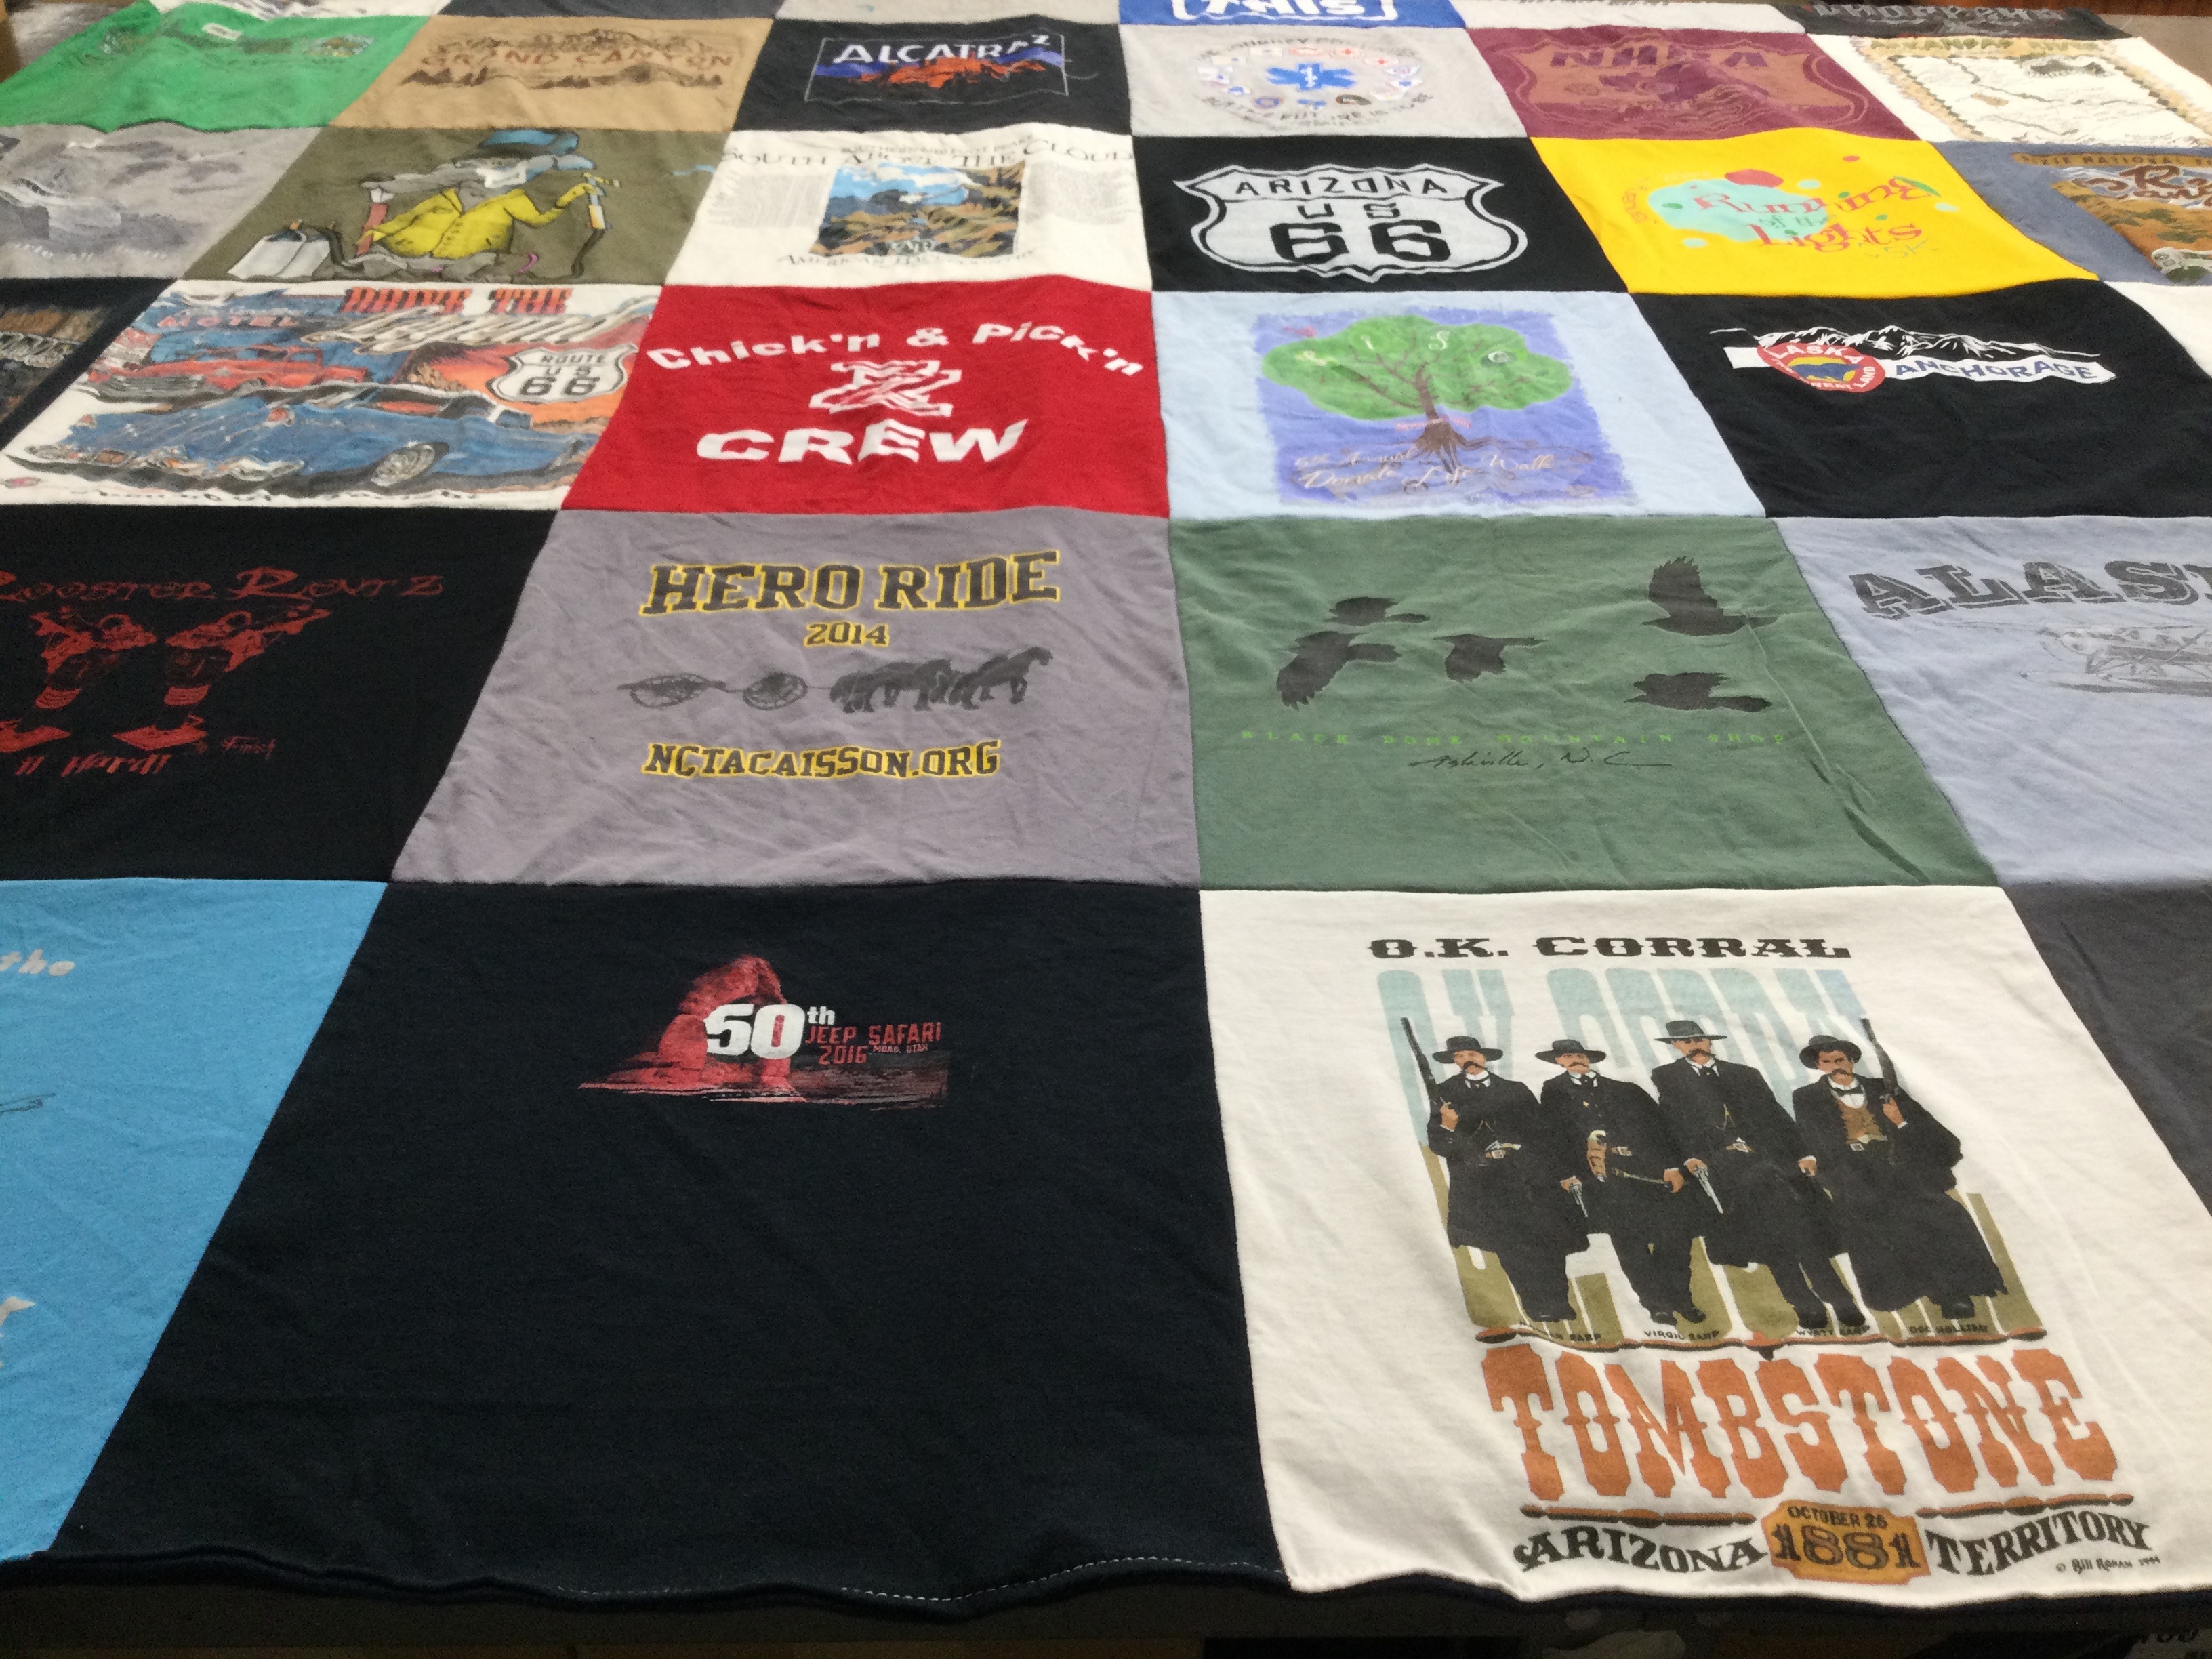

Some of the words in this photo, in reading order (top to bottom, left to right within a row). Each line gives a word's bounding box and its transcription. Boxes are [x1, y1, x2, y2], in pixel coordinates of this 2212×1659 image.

[832, 34, 1050, 64] ALCATRAZ
[1235, 177, 1449, 196] ARIZONA
[1692, 178, 1938, 213] Running
[1270, 219, 1451, 264] 66
[1746, 222, 1922, 253] Lights
[540, 354, 607, 364] ROUTE
[647, 332, 880, 371] Chick'n
[906, 327, 949, 348] &
[1895, 354, 2097, 381] ANCHORAGE
[519, 377, 600, 396] 66
[696, 419, 1029, 465] CREW
[638, 562, 864, 616] HERO
[874, 549, 1061, 611] RIDE
[802, 619, 890, 647] 2014
[1241, 729, 1350, 745] BLACK
[1382, 733, 1463, 745] DOME
[1496, 733, 1673, 744] MOUNTAIN
[1706, 733, 1785, 744] SHOP
[641, 740, 1002, 779] NCTACAISSON.ORG
[1355, 938, 1509, 958] O.K.
[1532, 936, 1852, 958] CORRAL
[805, 1025, 857, 1044] JEEP
[867, 1021, 943, 1046] SAFARI
[818, 1044, 869, 1065] 2016
[905, 1043, 928, 1054] UTAH
[1643, 1330, 1685, 1340] VIRGIL
[1688, 1330, 1720, 1342] EARP
[1481, 1348, 2119, 1502] TOMBSTONE
[1786, 1505, 1861, 1527] OCTOBER
[1864, 1512, 1889, 1529] 26
[1513, 1525, 1770, 1574] ARIZONA
[1770, 1523, 1922, 1570] 1881
[1926, 1511, 2154, 1578] TERRITORY
[2071, 1558, 2094, 1575] Bill
